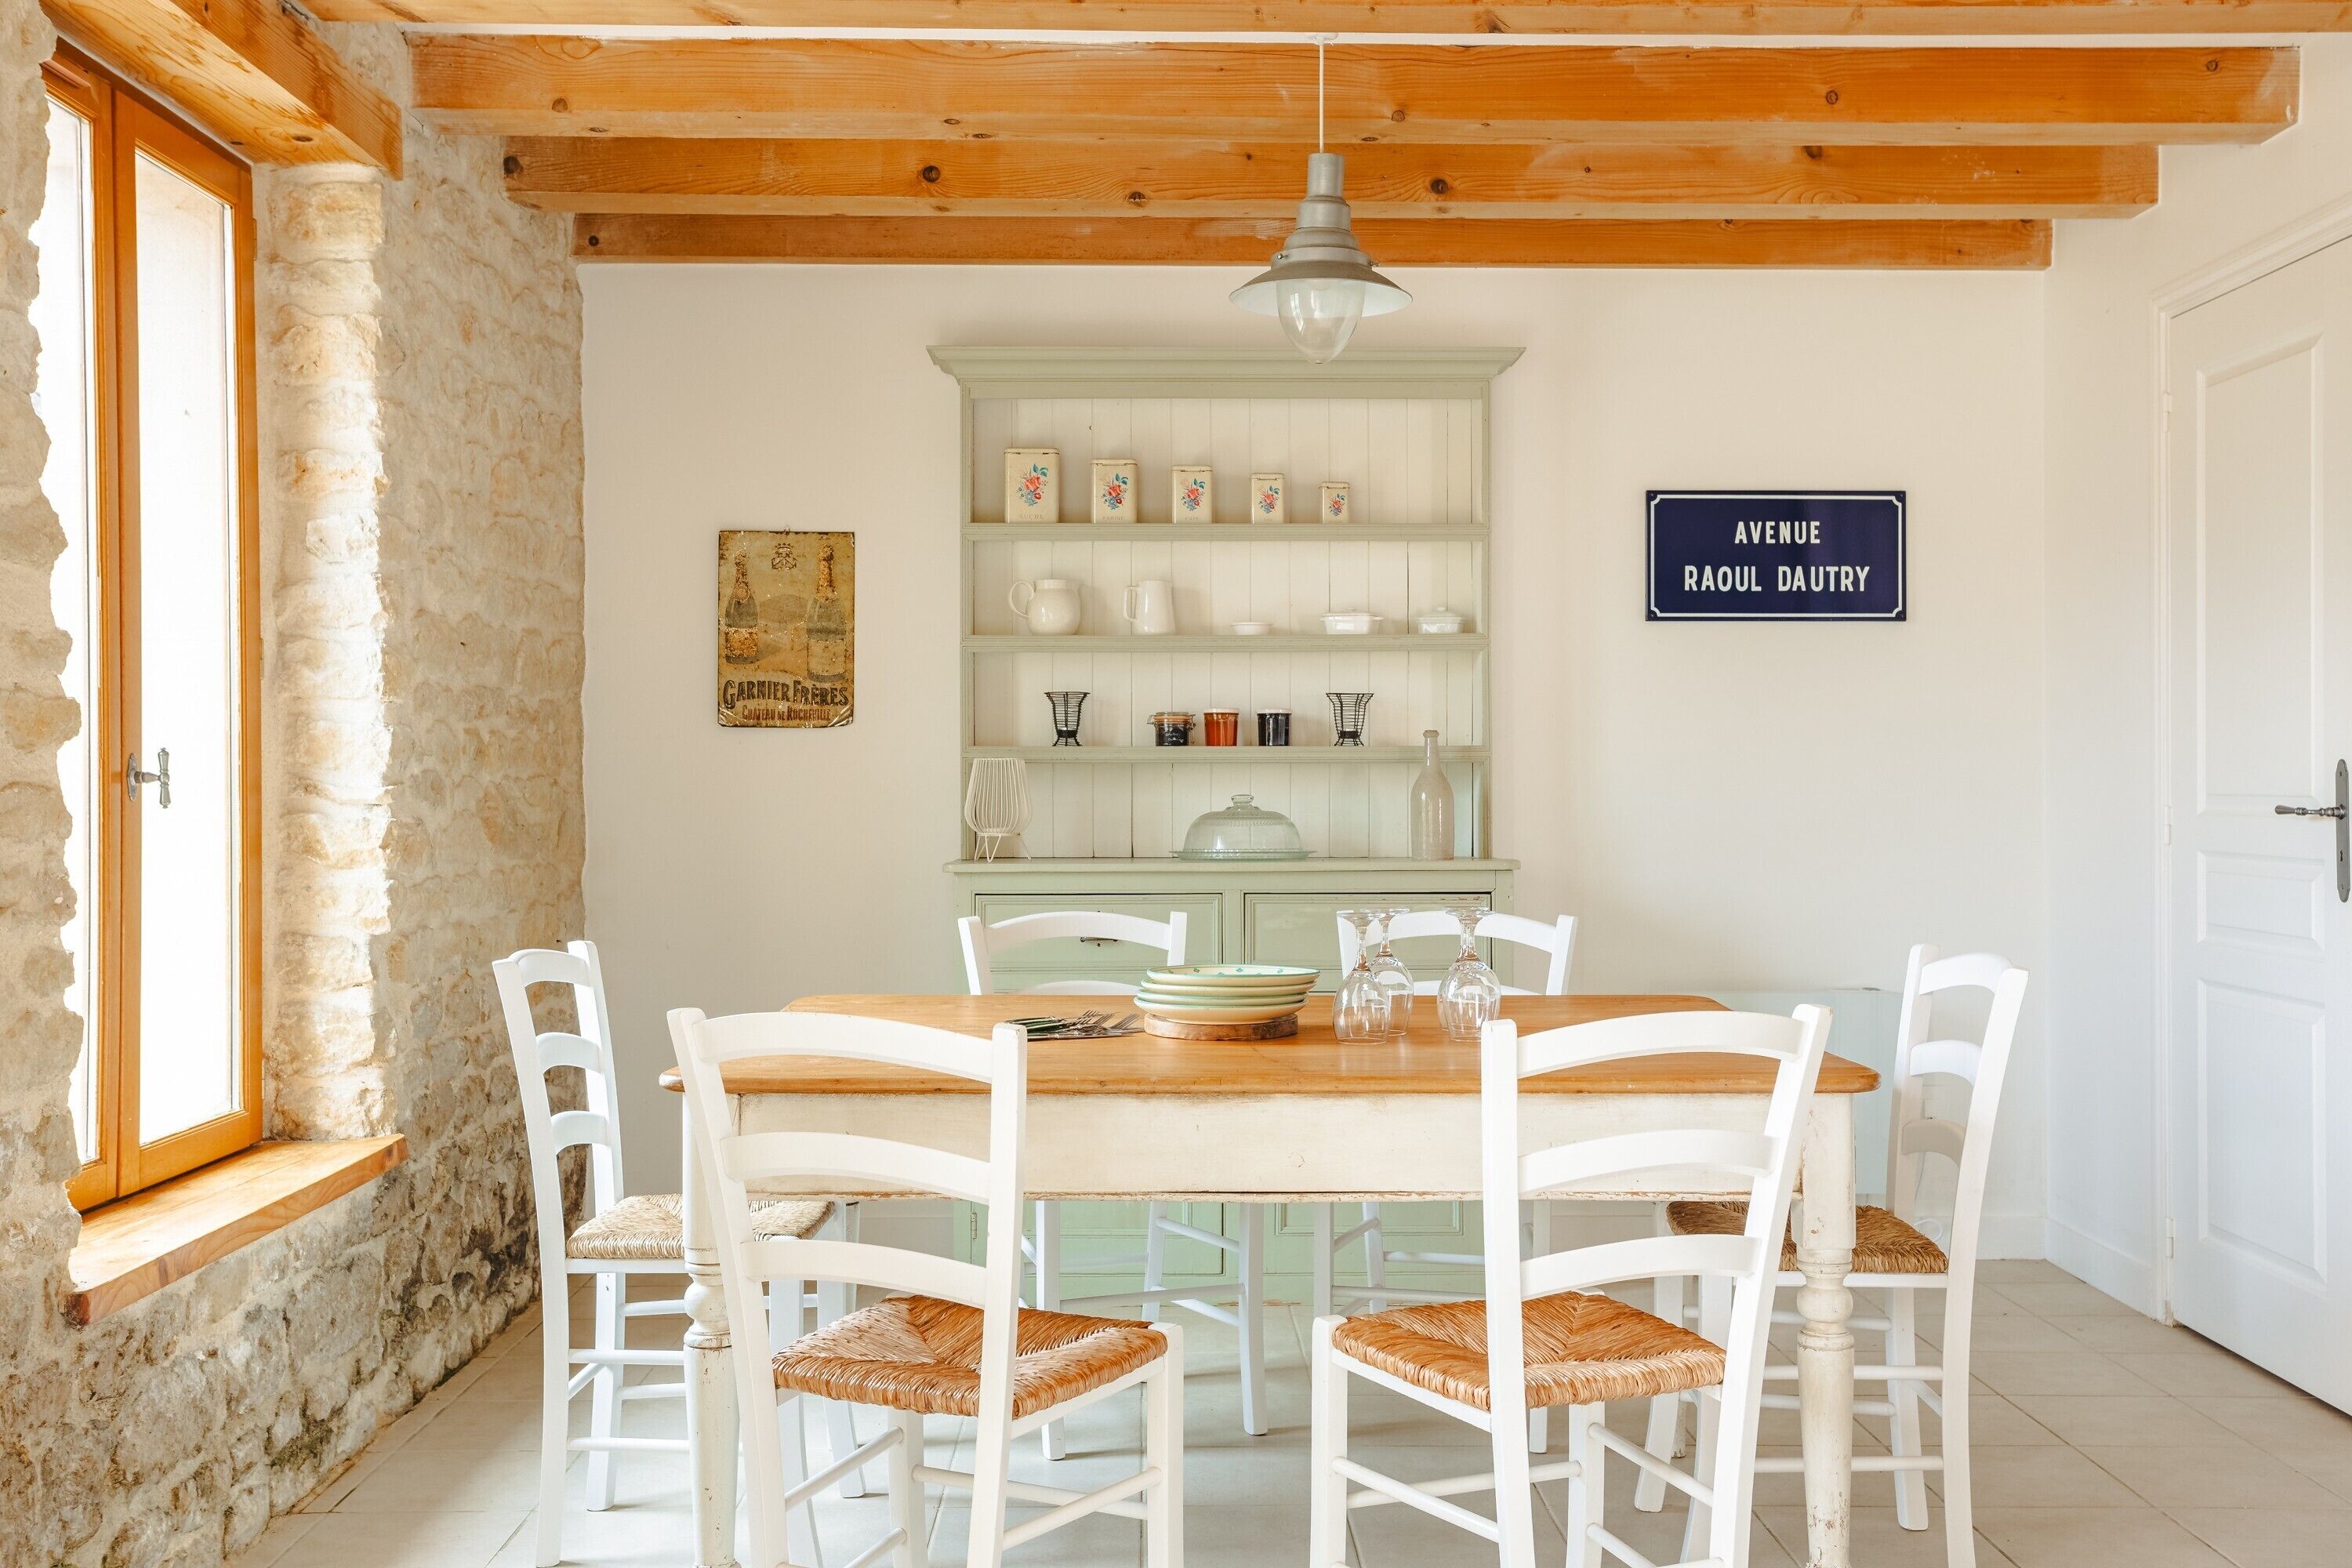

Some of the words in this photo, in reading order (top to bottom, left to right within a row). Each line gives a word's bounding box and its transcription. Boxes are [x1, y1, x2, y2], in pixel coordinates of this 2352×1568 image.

[1734, 521, 1820, 544] AVENUE
[1684, 565, 1762, 592] RAOUL
[1777, 565, 1871, 592] DAUTRY
[723, 680, 791, 710] GARNIER
